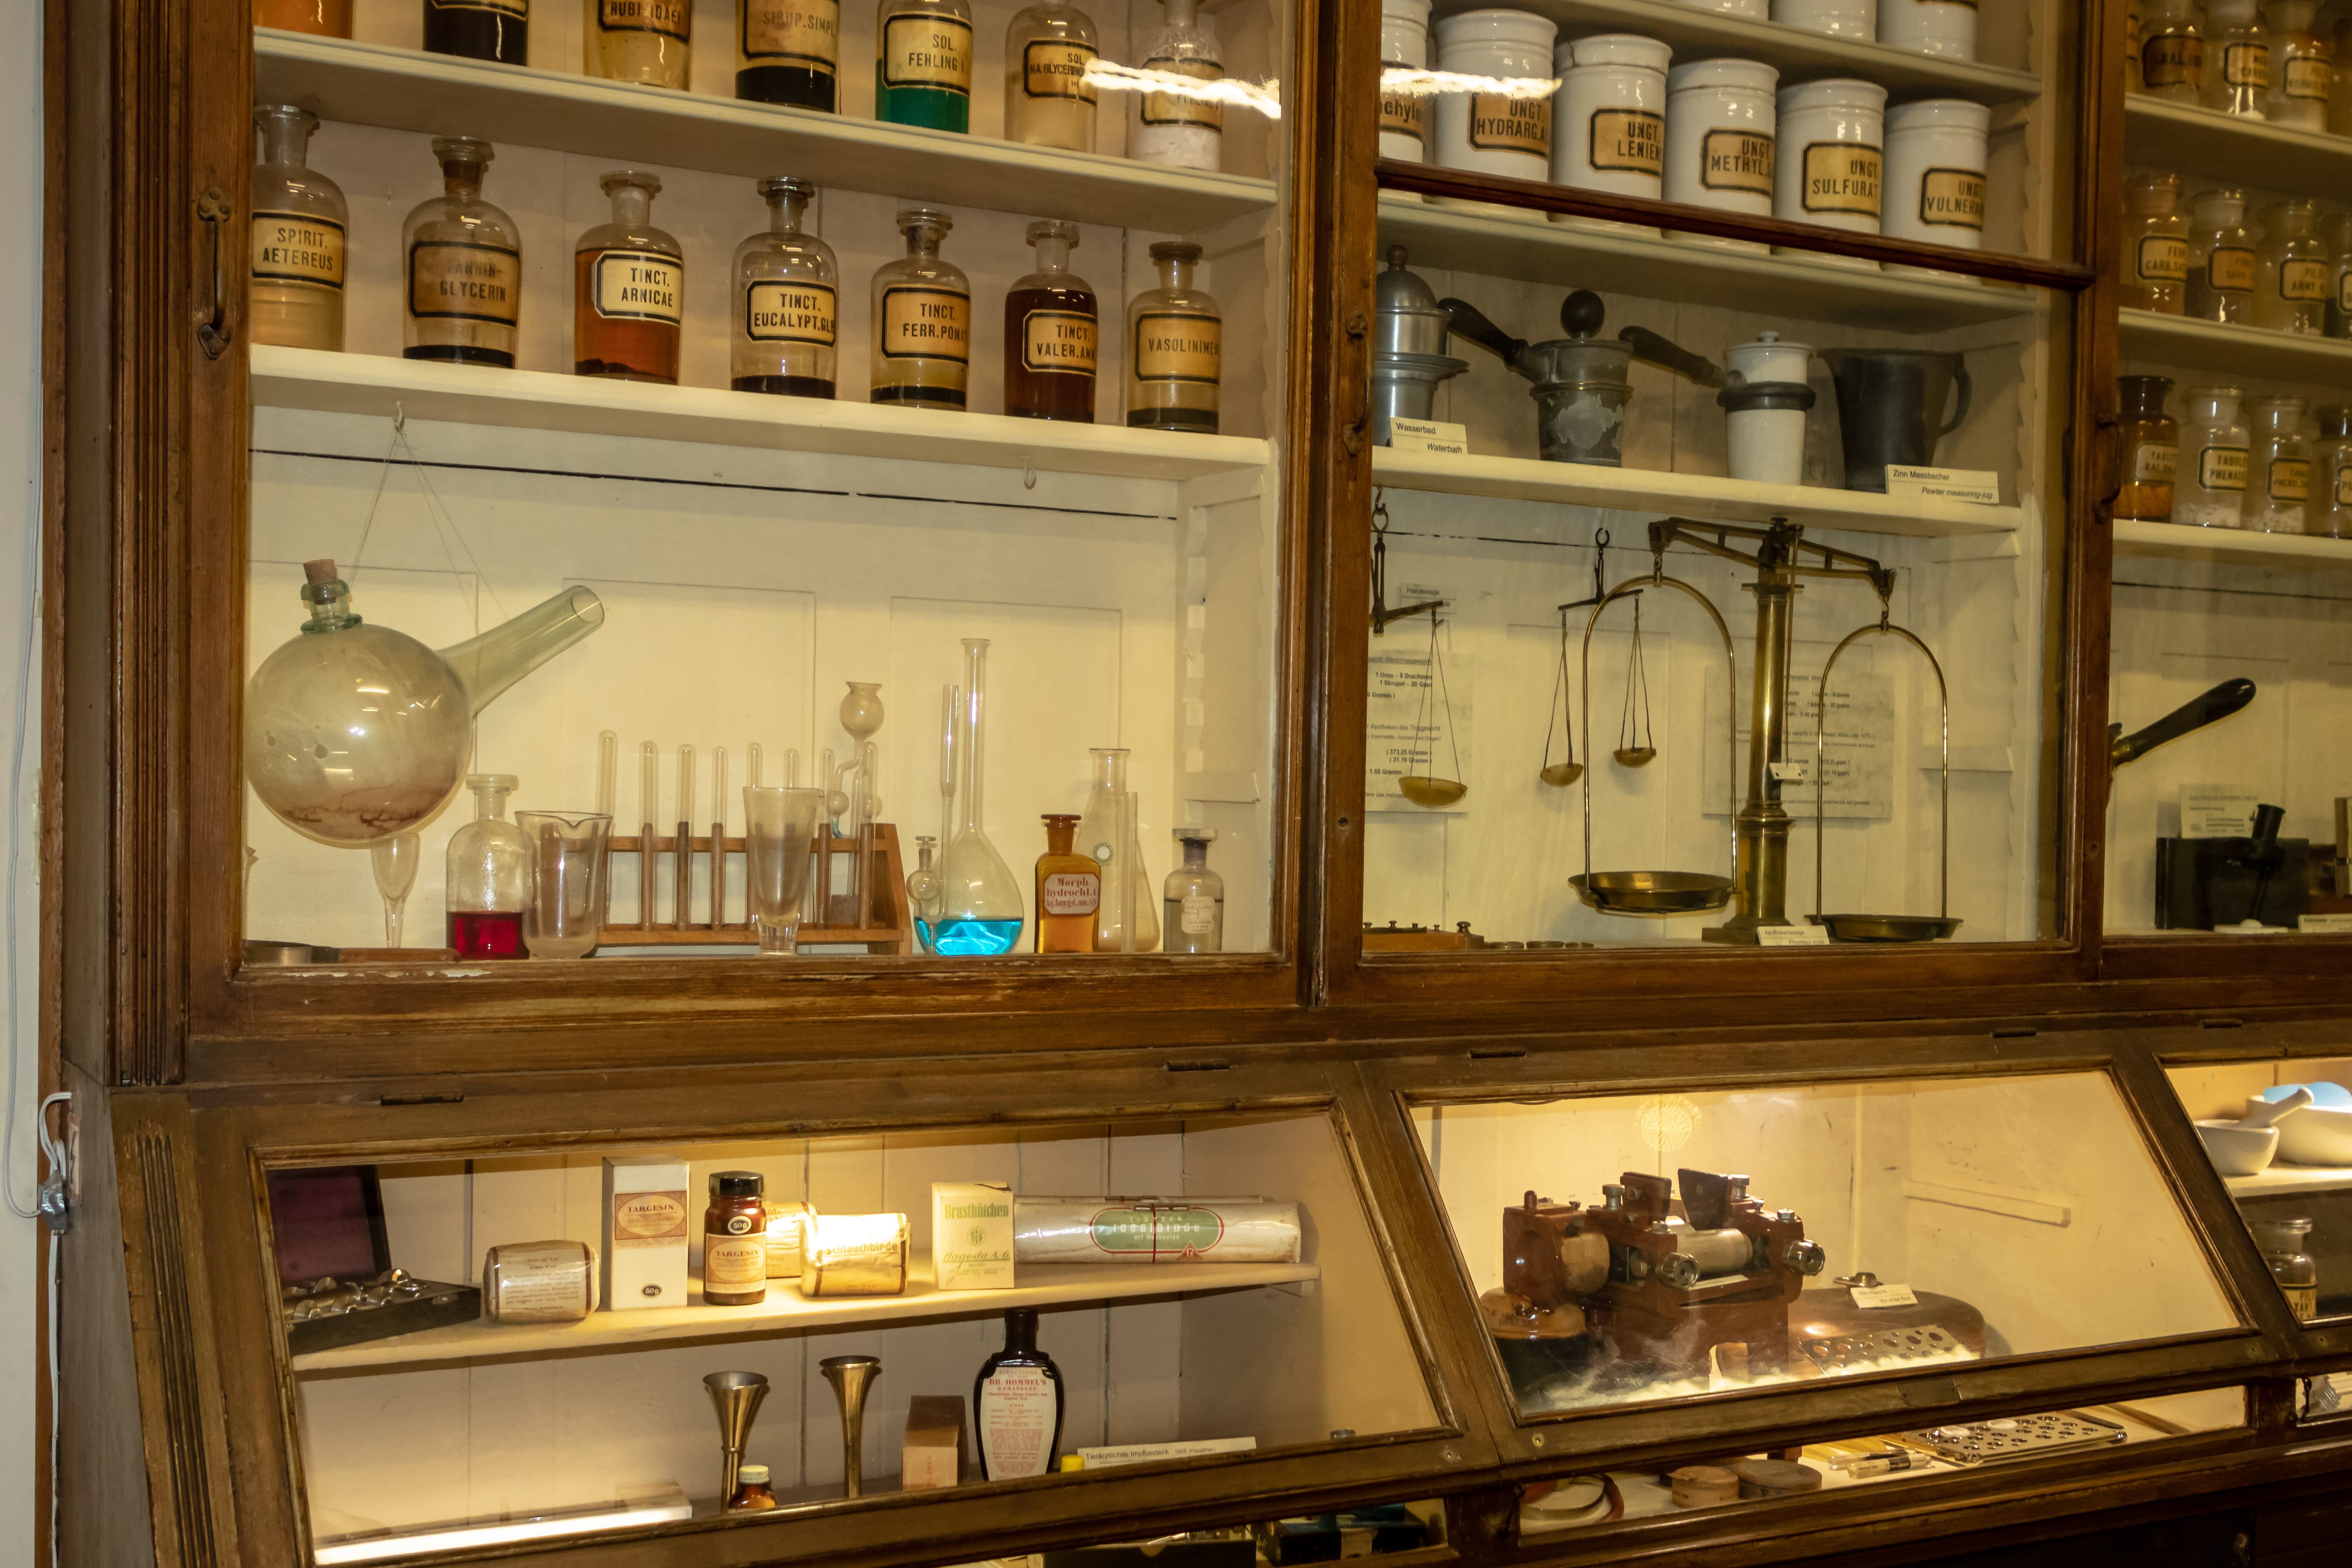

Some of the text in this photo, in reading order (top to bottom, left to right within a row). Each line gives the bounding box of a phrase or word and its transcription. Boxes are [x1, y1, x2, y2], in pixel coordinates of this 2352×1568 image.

[610, 2, 680, 24] RUBI IDAEI
[932, 34, 957, 52] SOL.
[908, 52, 958, 72] FEHLING
[1628, 120, 1659, 144] UNGT.
[277, 227, 328, 250] SPIRIT.
[263, 247, 333, 271] AETEREUS
[631, 268, 670, 287] TINCT.
[440, 279, 506, 302] GLYCERIN
[621, 287, 673, 308] ARNICAE
[780, 293, 821, 311] TINCT.
[920, 303, 956, 320] TINCT.
[1056, 324, 1090, 342] TINCT.
[1396, 422, 1436, 435] Wasserbad
[1427, 443, 1463, 453] Waterbath
[1893, 469, 1950, 481] Zinn Messbecher
[1921, 486, 1993, 500] Pewter measuring-jug
[1057, 877, 1090, 888] Morph.
[628, 1204, 675, 1213] TARGESIN
[945, 1202, 1009, 1219] Brusthütchen
[716, 1248, 758, 1258] TARGESIN
[826, 1240, 898, 1255] Schlauchbinde
[1086, 1452, 1129, 1460] Tierärztliches
[1130, 1449, 1169, 1458] Impfbesteck
